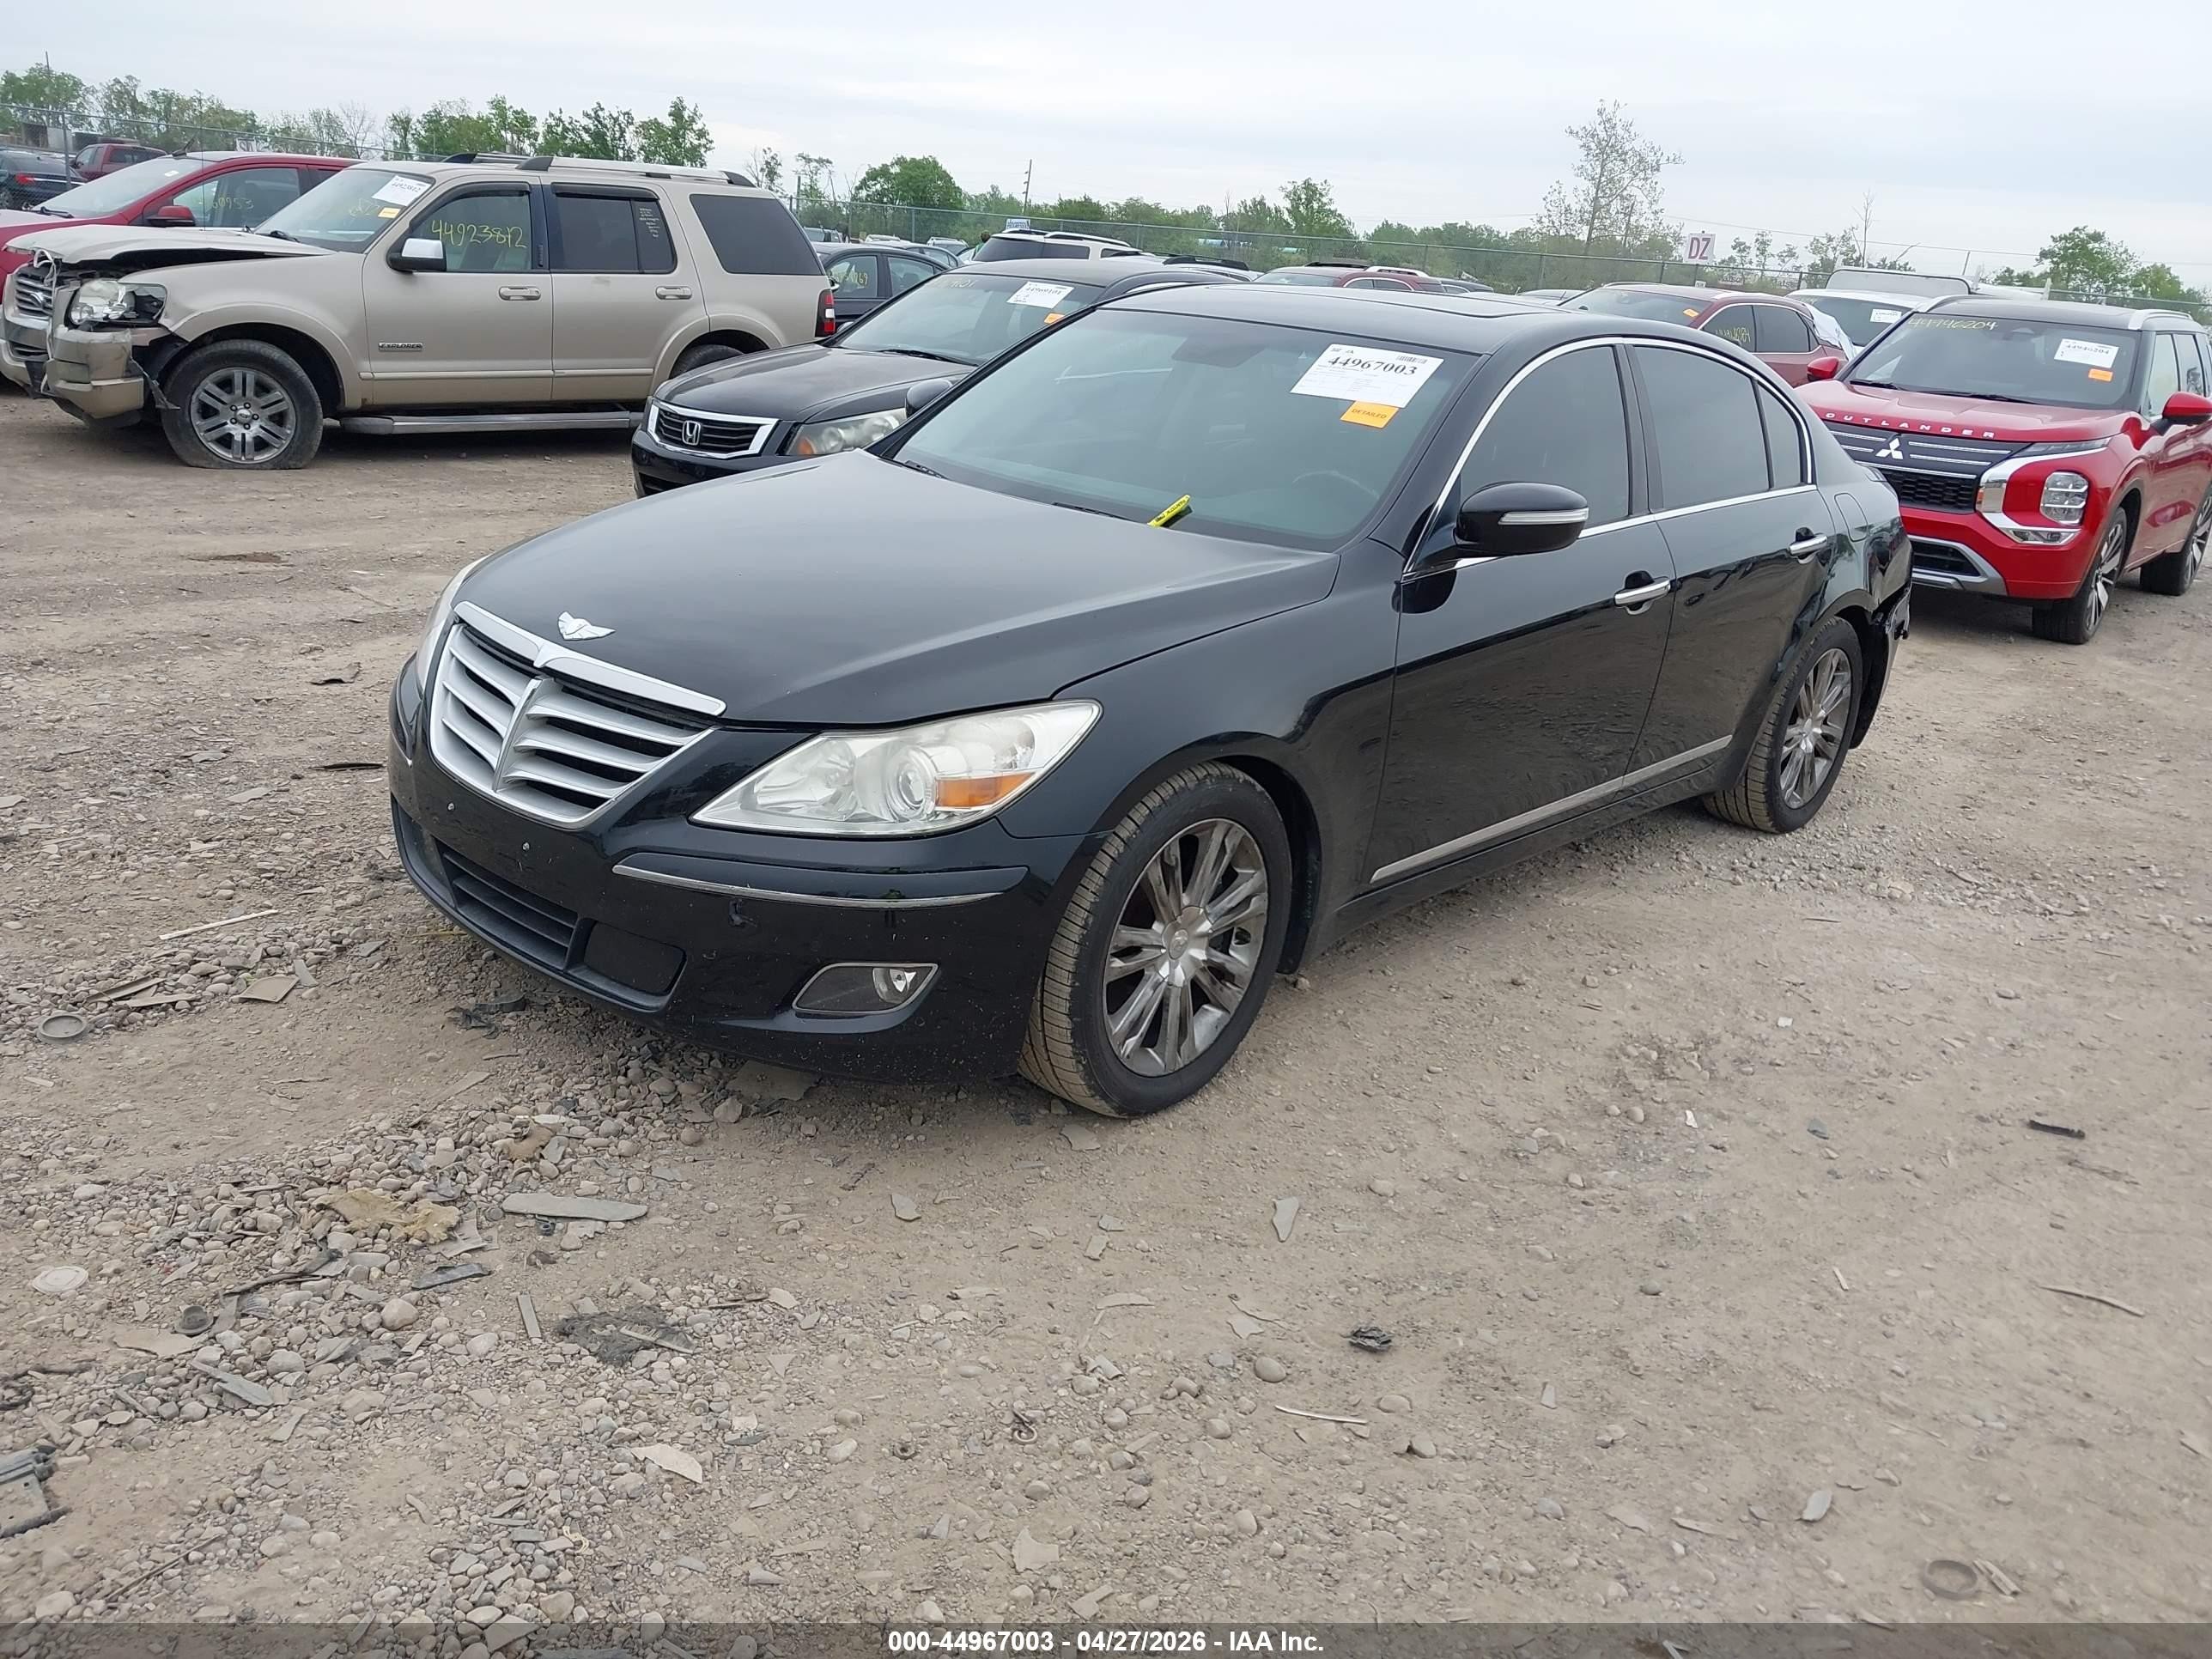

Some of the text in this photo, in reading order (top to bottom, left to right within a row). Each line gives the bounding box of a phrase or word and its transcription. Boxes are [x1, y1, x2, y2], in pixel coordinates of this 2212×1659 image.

[431, 219, 528, 248] 44923812
[1687, 237, 1711, 260] DZ
[1328, 356, 1418, 376] 44967003
[1351, 408, 1388, 419] DETAILED
[1826, 412, 1995, 438] OUTLANDER
